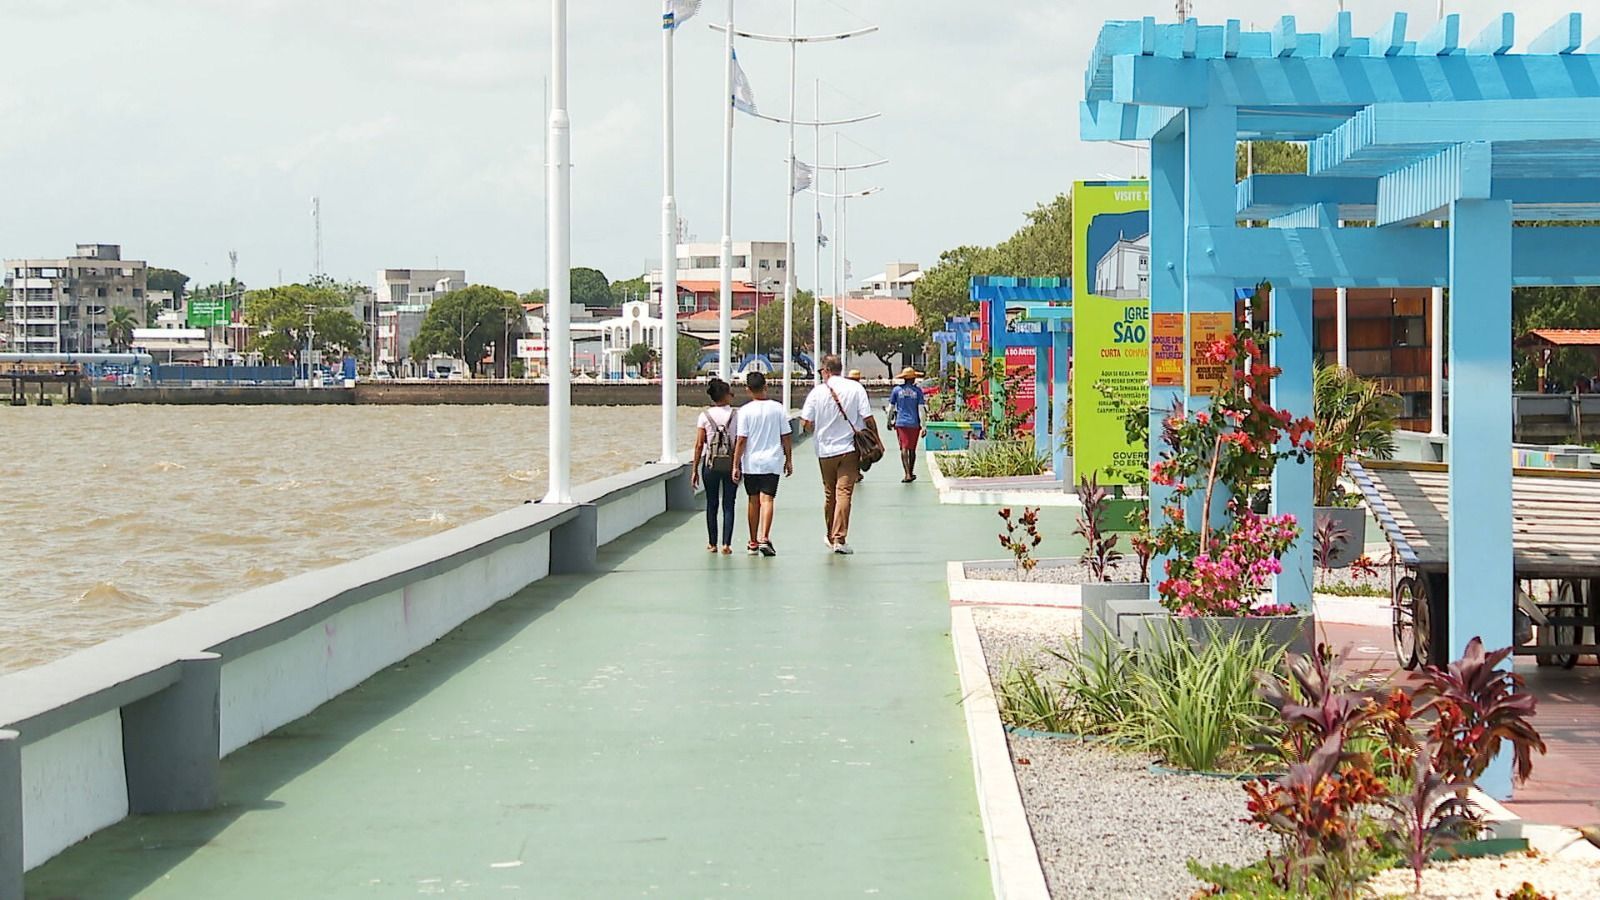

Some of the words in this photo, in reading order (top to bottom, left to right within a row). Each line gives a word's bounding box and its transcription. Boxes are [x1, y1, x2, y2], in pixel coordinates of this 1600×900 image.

[1114, 191, 1142, 201] VISITE
[1125, 306, 1149, 321] IGRE
[1019, 347, 1036, 355] ARTES
[1100, 348, 1121, 358] CURTA
[1124, 348, 1149, 358] COMPAR
[1113, 451, 1149, 459] GOVER
